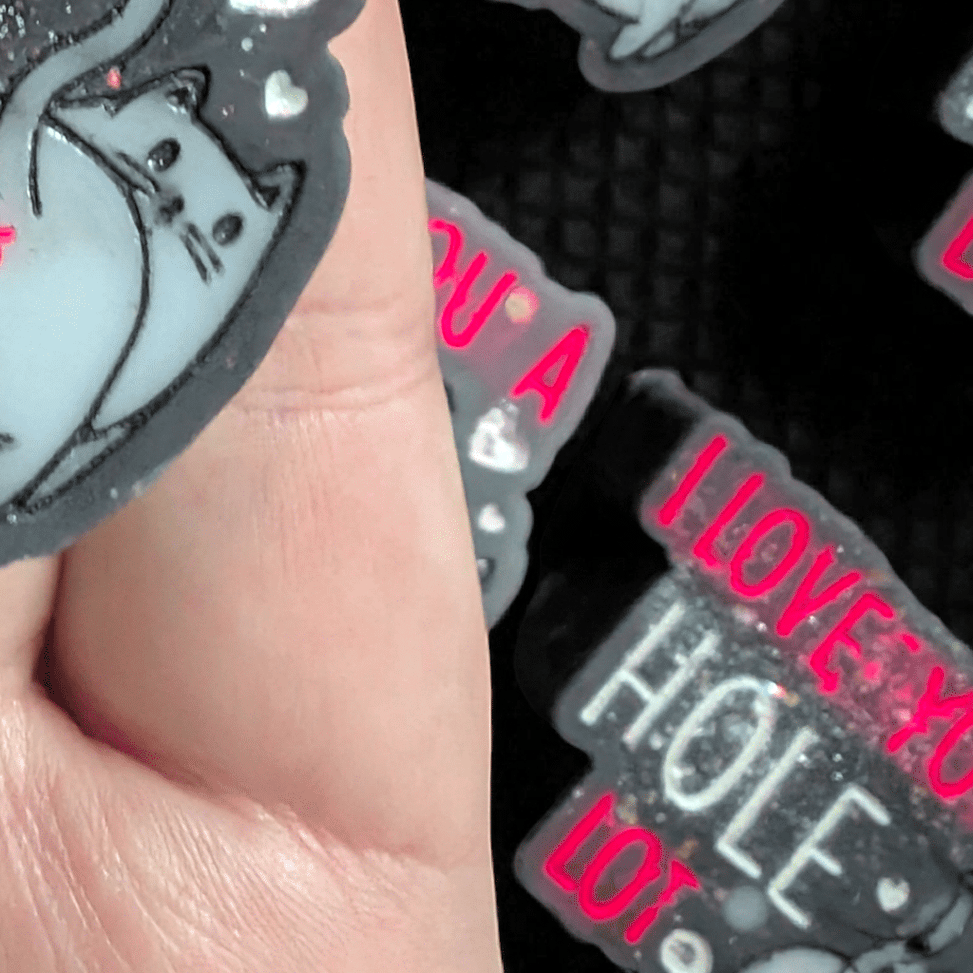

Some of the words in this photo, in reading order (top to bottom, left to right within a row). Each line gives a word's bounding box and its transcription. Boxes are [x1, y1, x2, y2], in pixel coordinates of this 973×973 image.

[510, 324, 590, 422] A
[655, 433, 729, 529] I
[691, 471, 896, 695] LOVE
[579, 601, 891, 928] HOLE
[542, 791, 701, 946] LOT
